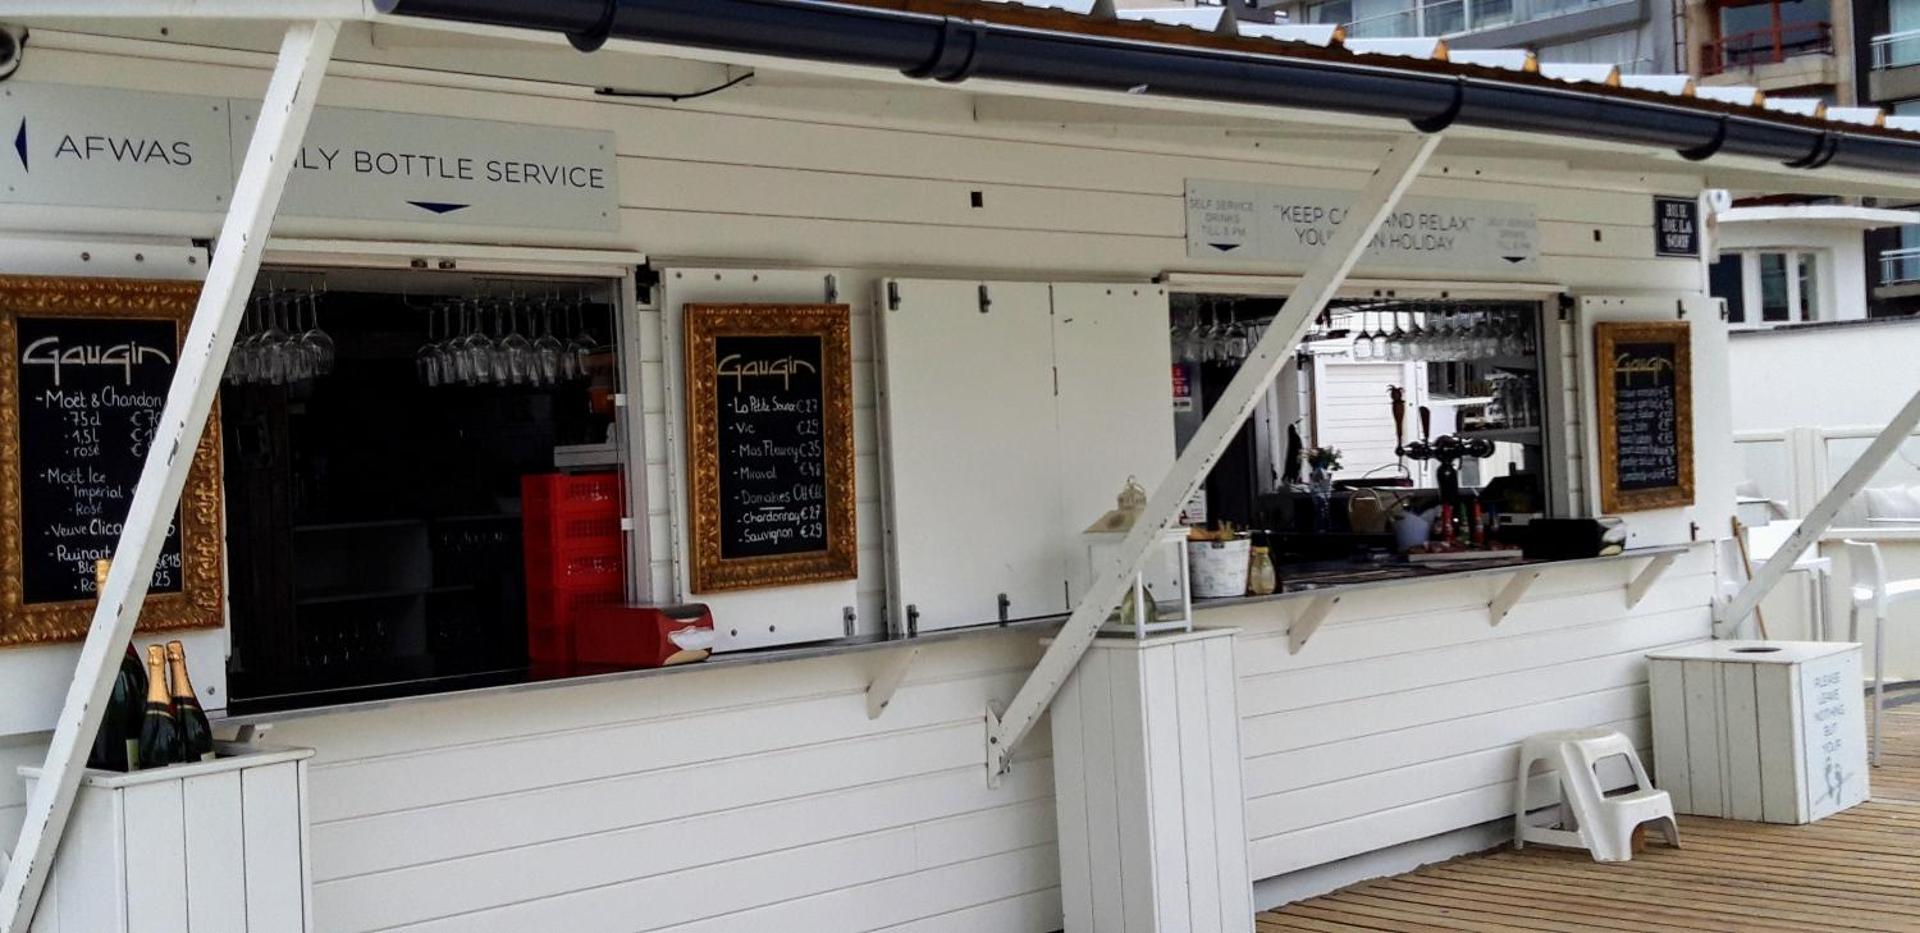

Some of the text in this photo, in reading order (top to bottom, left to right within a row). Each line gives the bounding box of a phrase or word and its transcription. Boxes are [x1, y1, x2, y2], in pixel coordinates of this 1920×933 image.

[55, 134, 193, 166] AFWAS
[355, 150, 474, 181] BOTTLE
[486, 160, 605, 189] SERVICE
[22, 336, 171, 386] Gaugin
[716, 353, 816, 393] Gaugin
[91, 393, 100, 407] &
[101, 386, 162, 407] Chandon
[733, 396, 749, 413] La
[735, 421, 756, 434] Vic
[739, 443, 762, 458] Mas
[87, 465, 106, 483] Ice
[740, 463, 777, 480] Miraval
[51, 523, 88, 537] Veuve
[800, 522, 823, 538] €29
[77, 561, 97, 575] Bla
